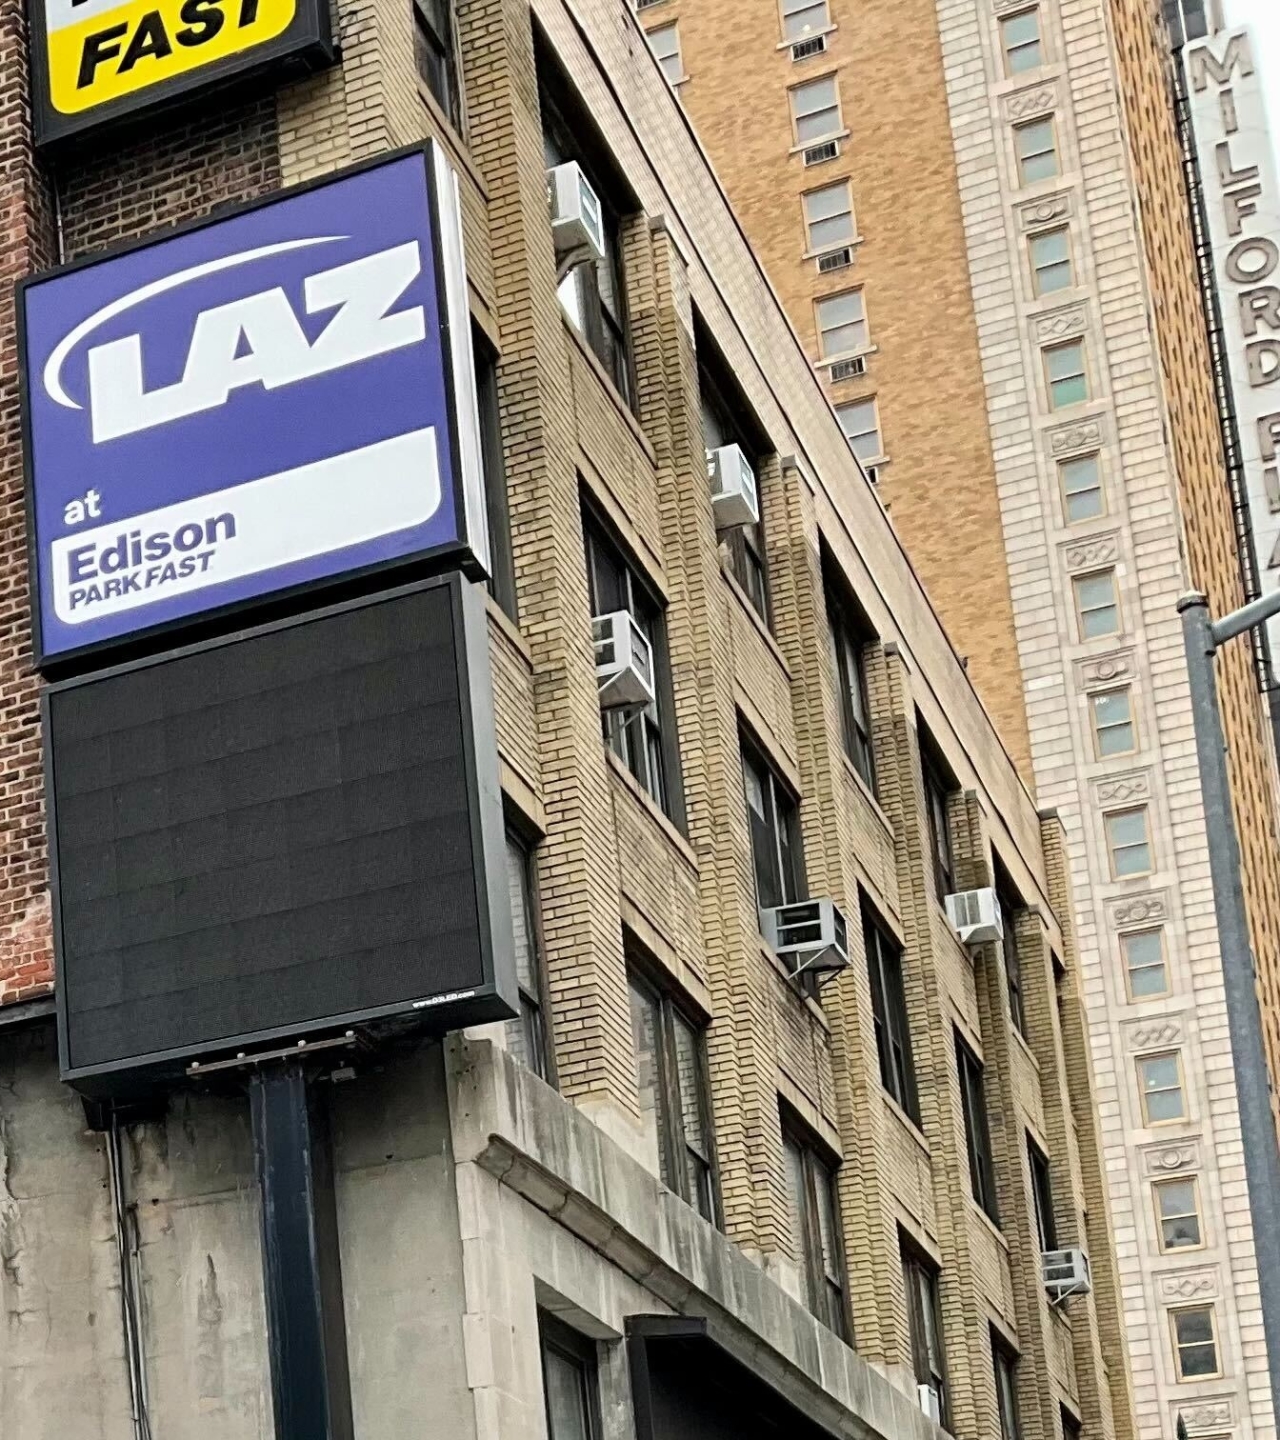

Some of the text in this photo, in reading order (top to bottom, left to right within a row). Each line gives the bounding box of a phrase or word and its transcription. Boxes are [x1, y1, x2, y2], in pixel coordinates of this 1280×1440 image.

[88, 240, 426, 443] LAZ
[62, 489, 101, 524] at
[66, 508, 237, 585] Edison
[68, 549, 216, 611] PARK FAST
